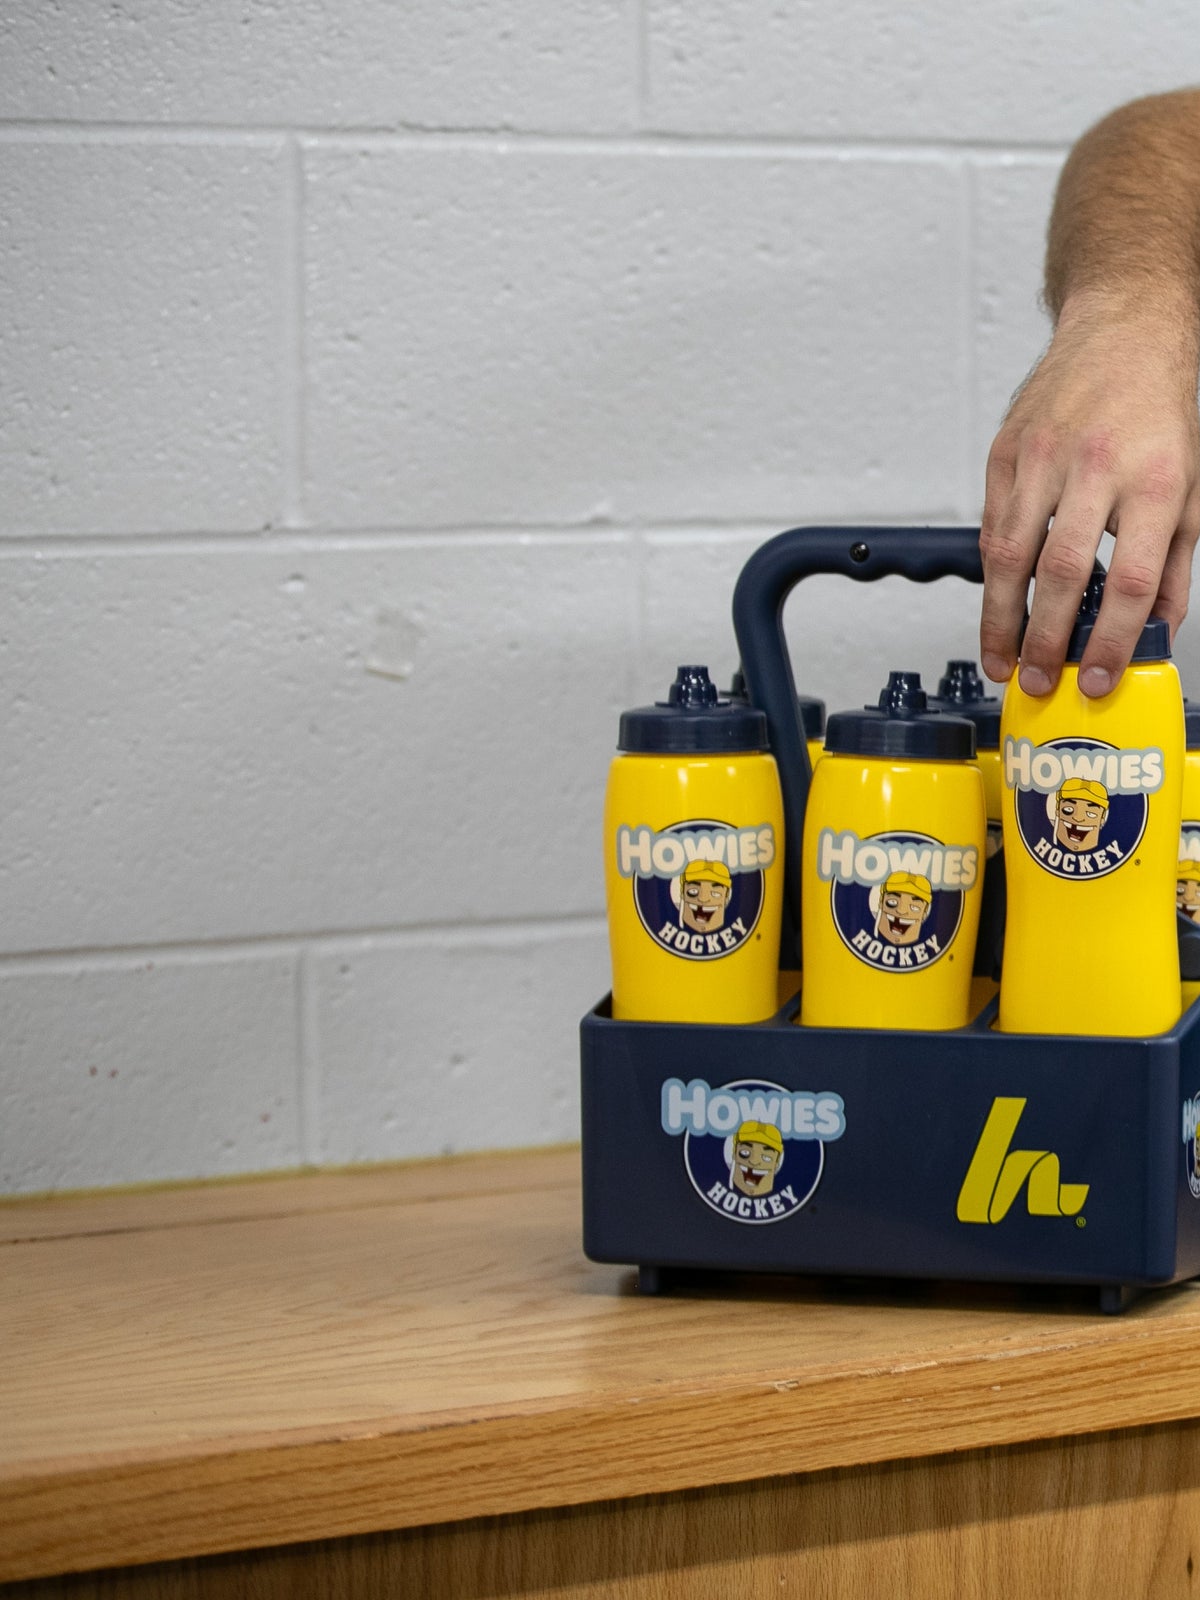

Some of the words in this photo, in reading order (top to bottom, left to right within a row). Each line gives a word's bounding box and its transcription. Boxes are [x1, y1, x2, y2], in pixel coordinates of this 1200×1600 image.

[1004, 739, 1163, 791] HOWIES
[618, 826, 775, 875] HOWIES
[820, 831, 979, 887] HOWIES
[1033, 836, 1124, 874] HOCKEY
[657, 916, 748, 954] HOCKEY
[851, 928, 942, 967] HOCKEY
[666, 1083, 842, 1136] HOWIES
[706, 1180, 799, 1219] HOCKEY
